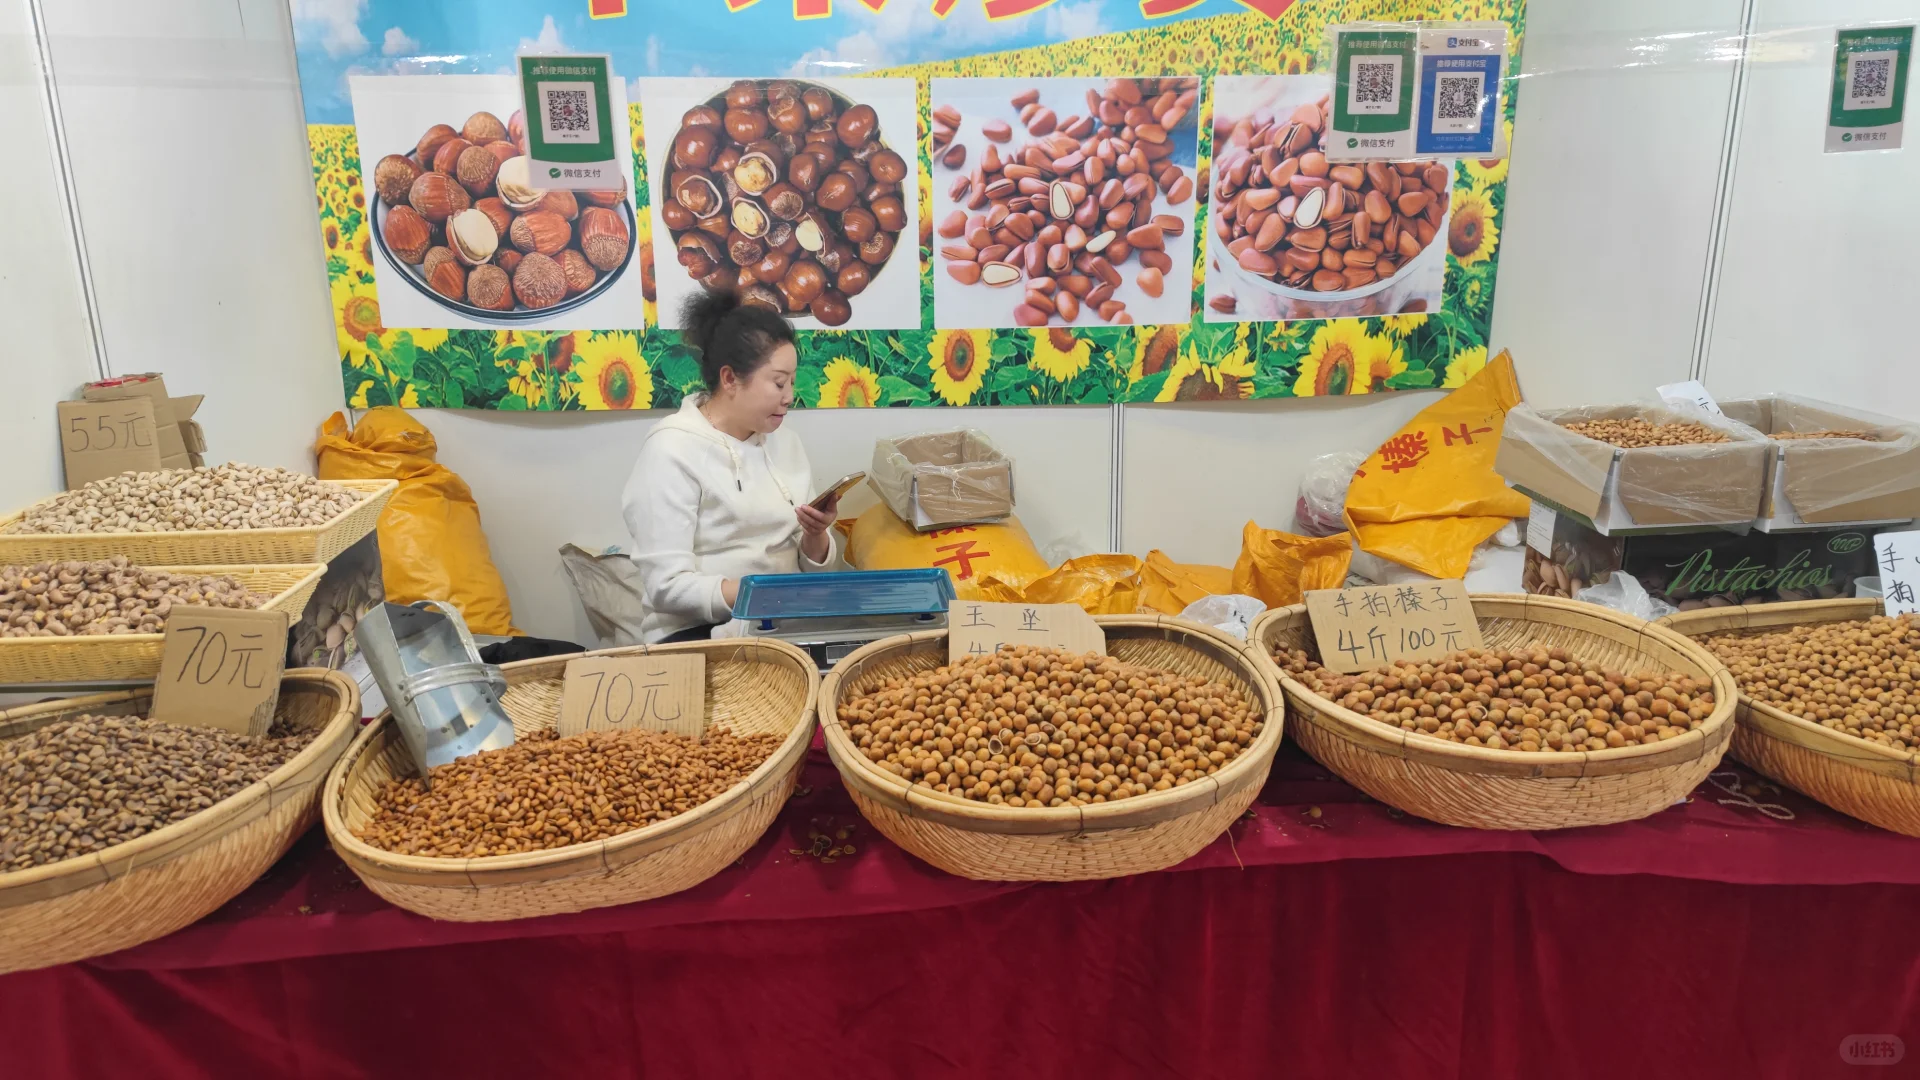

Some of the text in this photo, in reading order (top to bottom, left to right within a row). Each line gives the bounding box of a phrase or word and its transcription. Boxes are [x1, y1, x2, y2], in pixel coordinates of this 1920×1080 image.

[1436, 59, 1487, 68] 推荐使用支付宝
[1360, 138, 1396, 148] 微信支付
[1854, 131, 1887, 142] 微信支付
[563, 168, 601, 178] 微信支付
[68, 412, 153, 453] 55元
[1664, 548, 1833, 596] Pistachios
[1333, 586, 1458, 618] 手拍榛子
[176, 626, 265, 689] 70元
[580, 671, 682, 729] 70元
